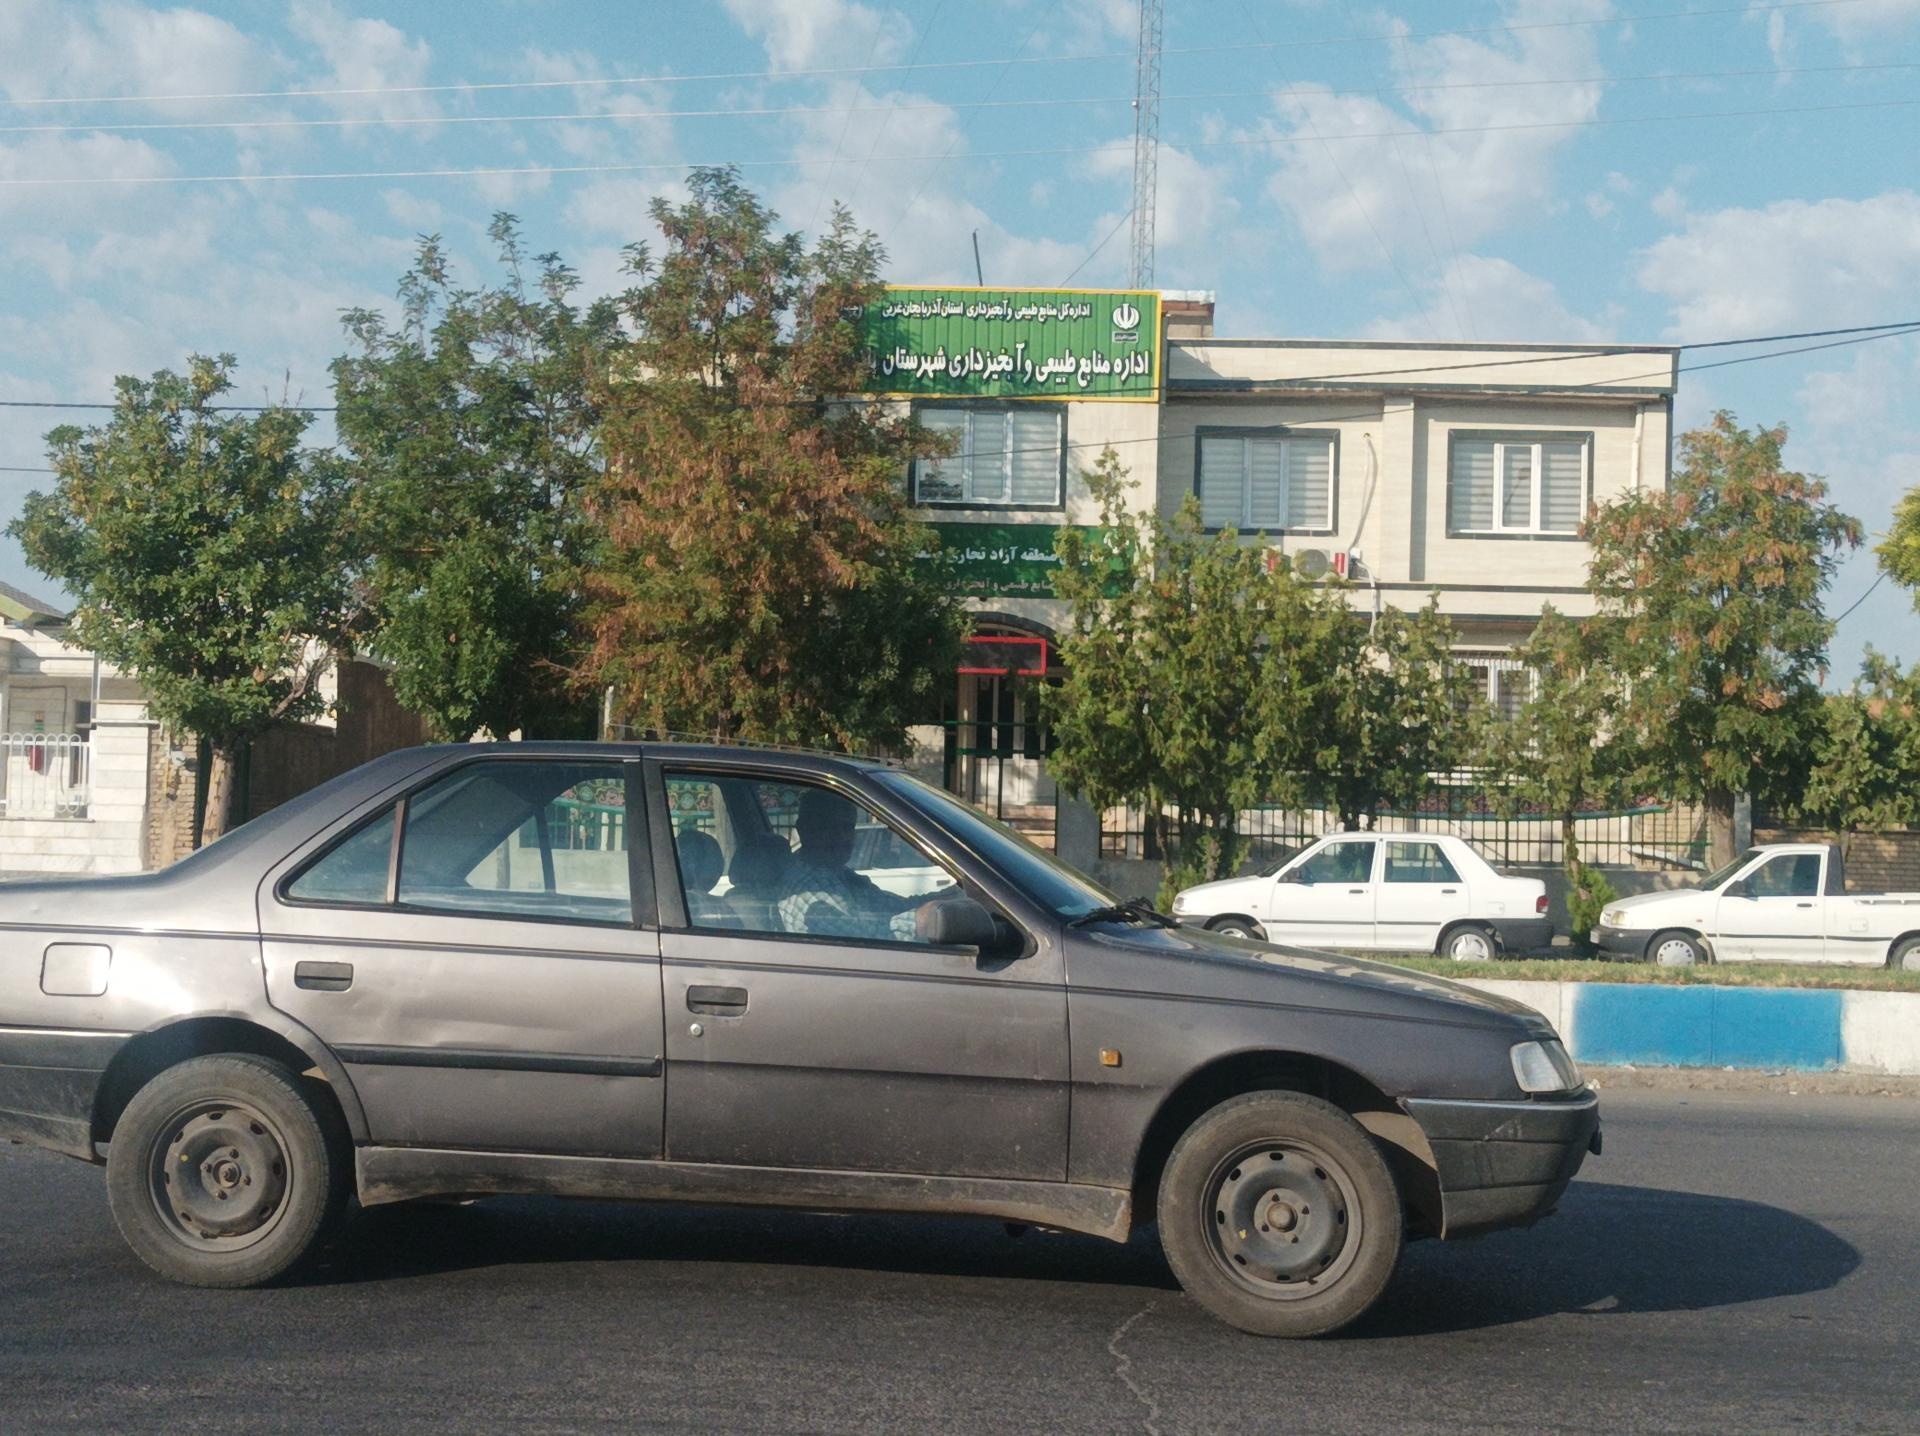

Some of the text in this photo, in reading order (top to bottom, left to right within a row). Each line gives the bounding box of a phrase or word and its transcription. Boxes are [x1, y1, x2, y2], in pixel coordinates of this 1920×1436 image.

[882, 301, 903, 317] غربی
[903, 297, 942, 317] آذربایجان
[942, 301, 963, 316] استان
[1014, 303, 1037, 320] طبیعی
[1037, 303, 1057, 322] منابع
[883, 345, 947, 379] شهرستان
[1023, 358, 1032, 383] و
[1035, 348, 1076, 383] طبیعی
[1077, 349, 1111, 388] منابع
[1113, 350, 1149, 381] اداره
[989, 546, 1018, 564] آزاد
